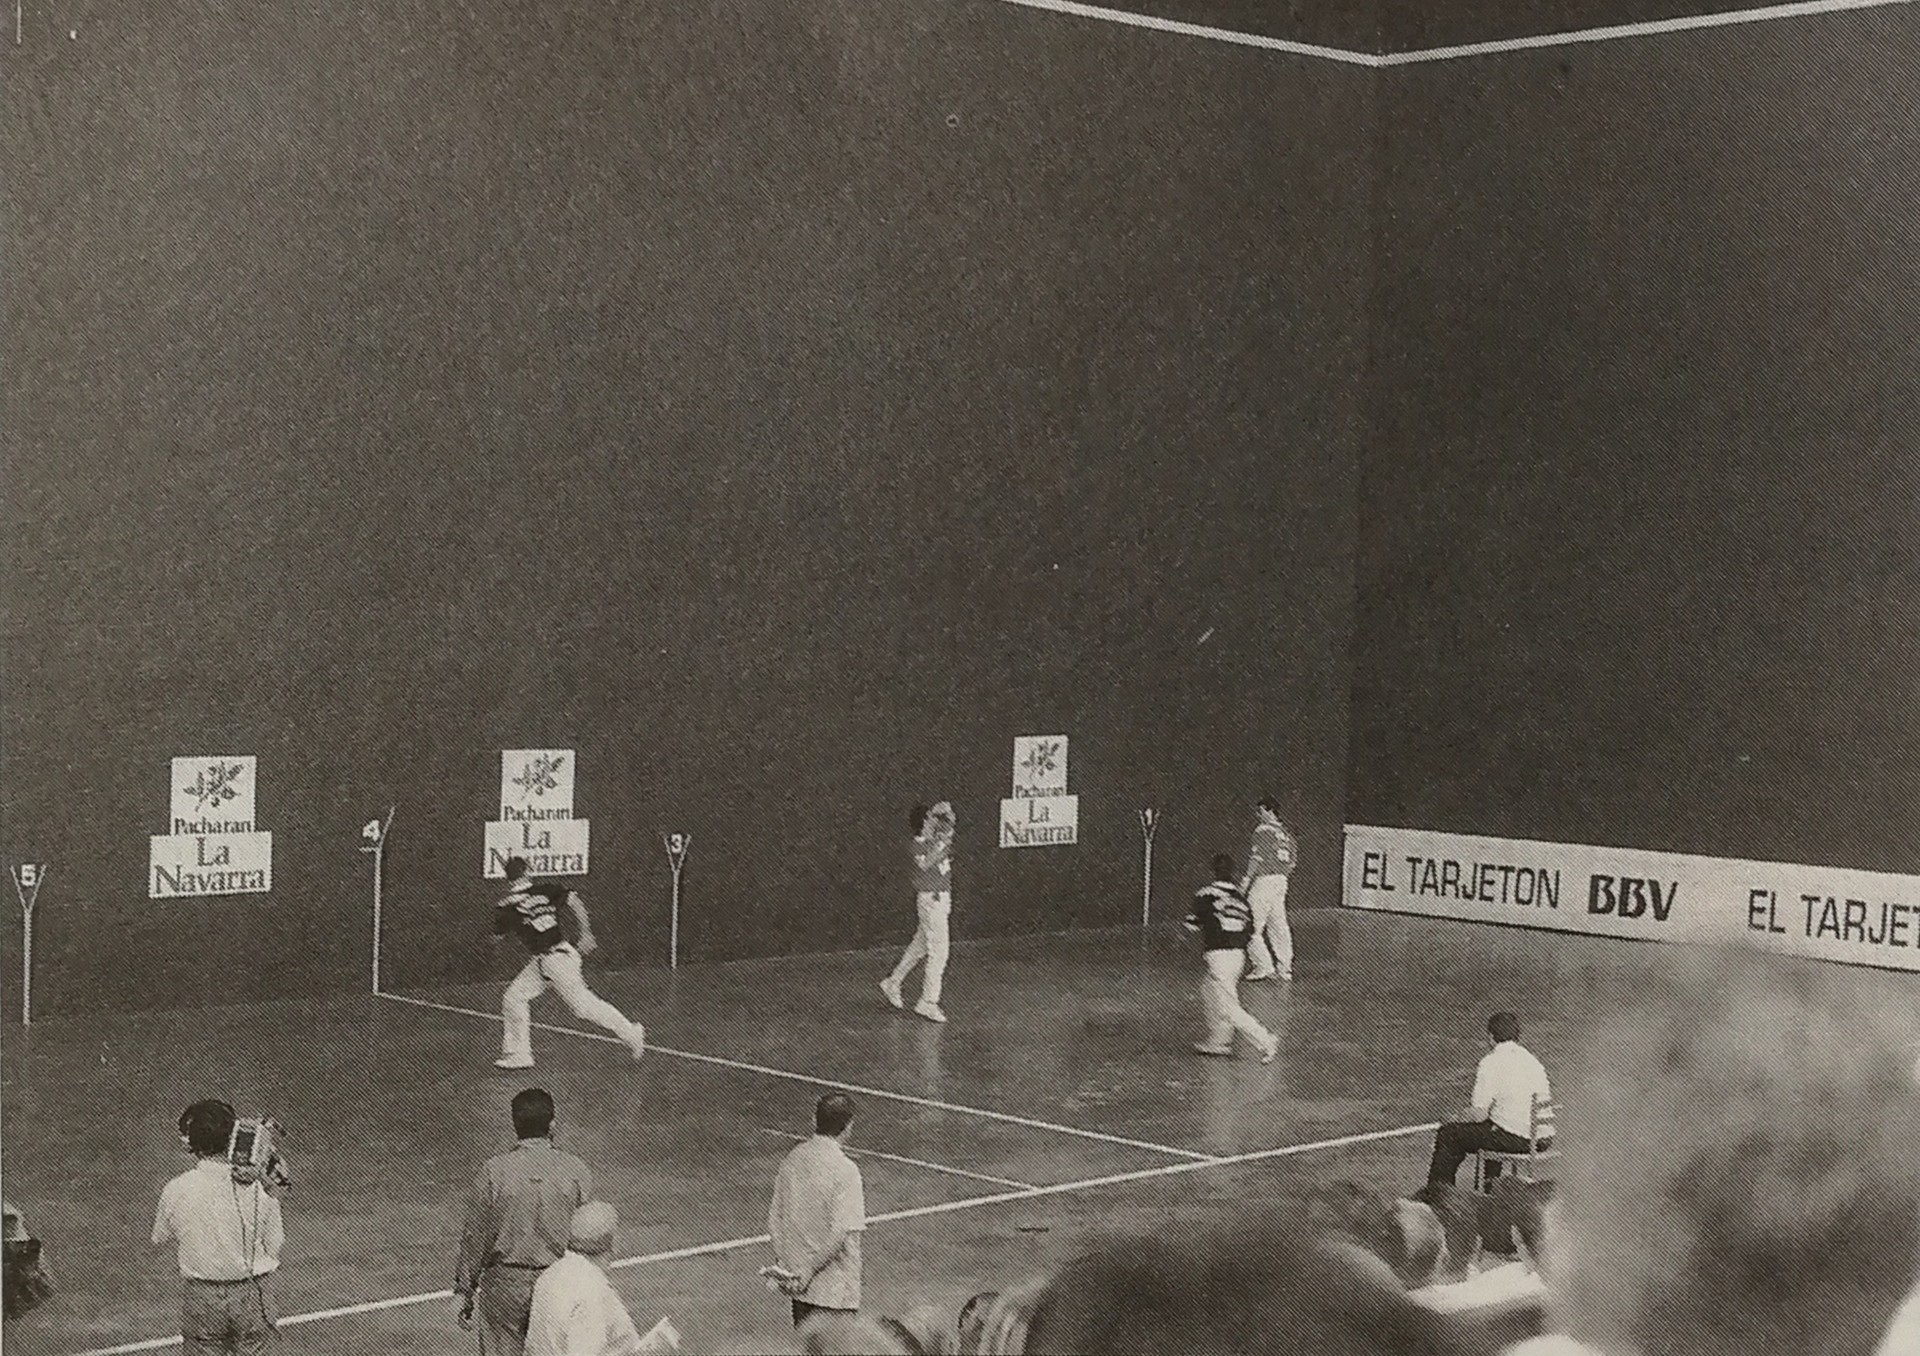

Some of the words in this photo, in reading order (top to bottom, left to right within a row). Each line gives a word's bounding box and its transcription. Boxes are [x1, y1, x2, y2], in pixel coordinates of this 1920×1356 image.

[504, 805, 571, 821] Pacharan
[1028, 799, 1050, 824] La
[173, 817, 252, 836] Pacharan
[362, 819, 381, 842] 4
[521, 822, 551, 849] La
[1003, 821, 1074, 845] Navarra
[195, 836, 230, 867] La
[670, 833, 682, 854] 3
[20, 863, 36, 887] 5
[154, 864, 266, 894] Navarra
[1361, 851, 1395, 892] EL
[1405, 855, 1560, 910] TARJETON
[1587, 873, 1678, 922] BBV
[1748, 888, 1786, 934] EL
